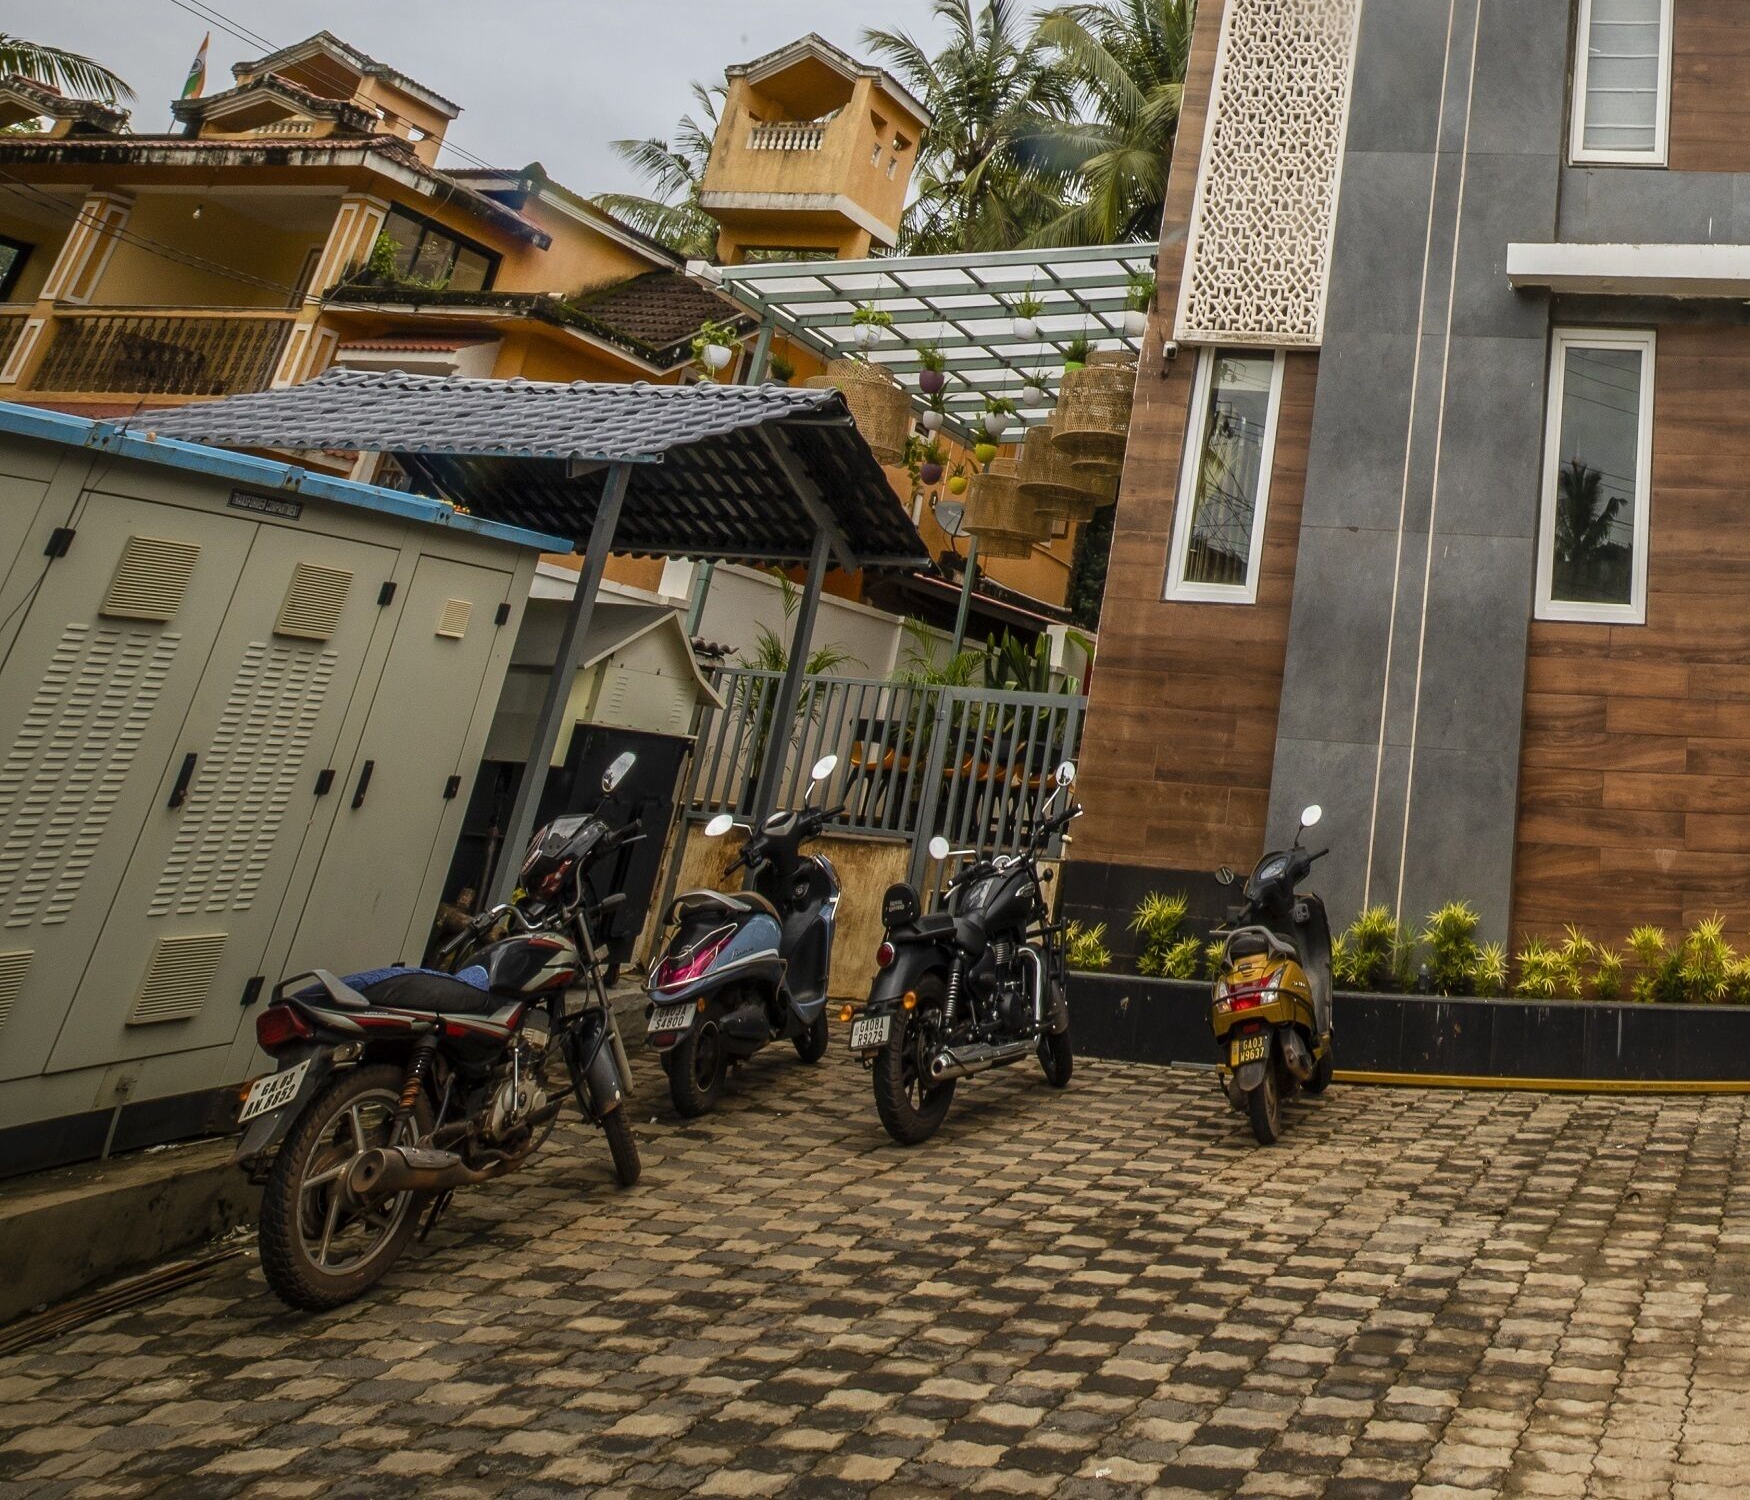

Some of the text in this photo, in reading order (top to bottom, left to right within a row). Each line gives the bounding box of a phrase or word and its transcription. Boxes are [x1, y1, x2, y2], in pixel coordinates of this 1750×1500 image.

[860, 1017, 884, 1033] GA08A
[858, 1030, 883, 1047] R9279
[1242, 1036, 1263, 1051] GA03
